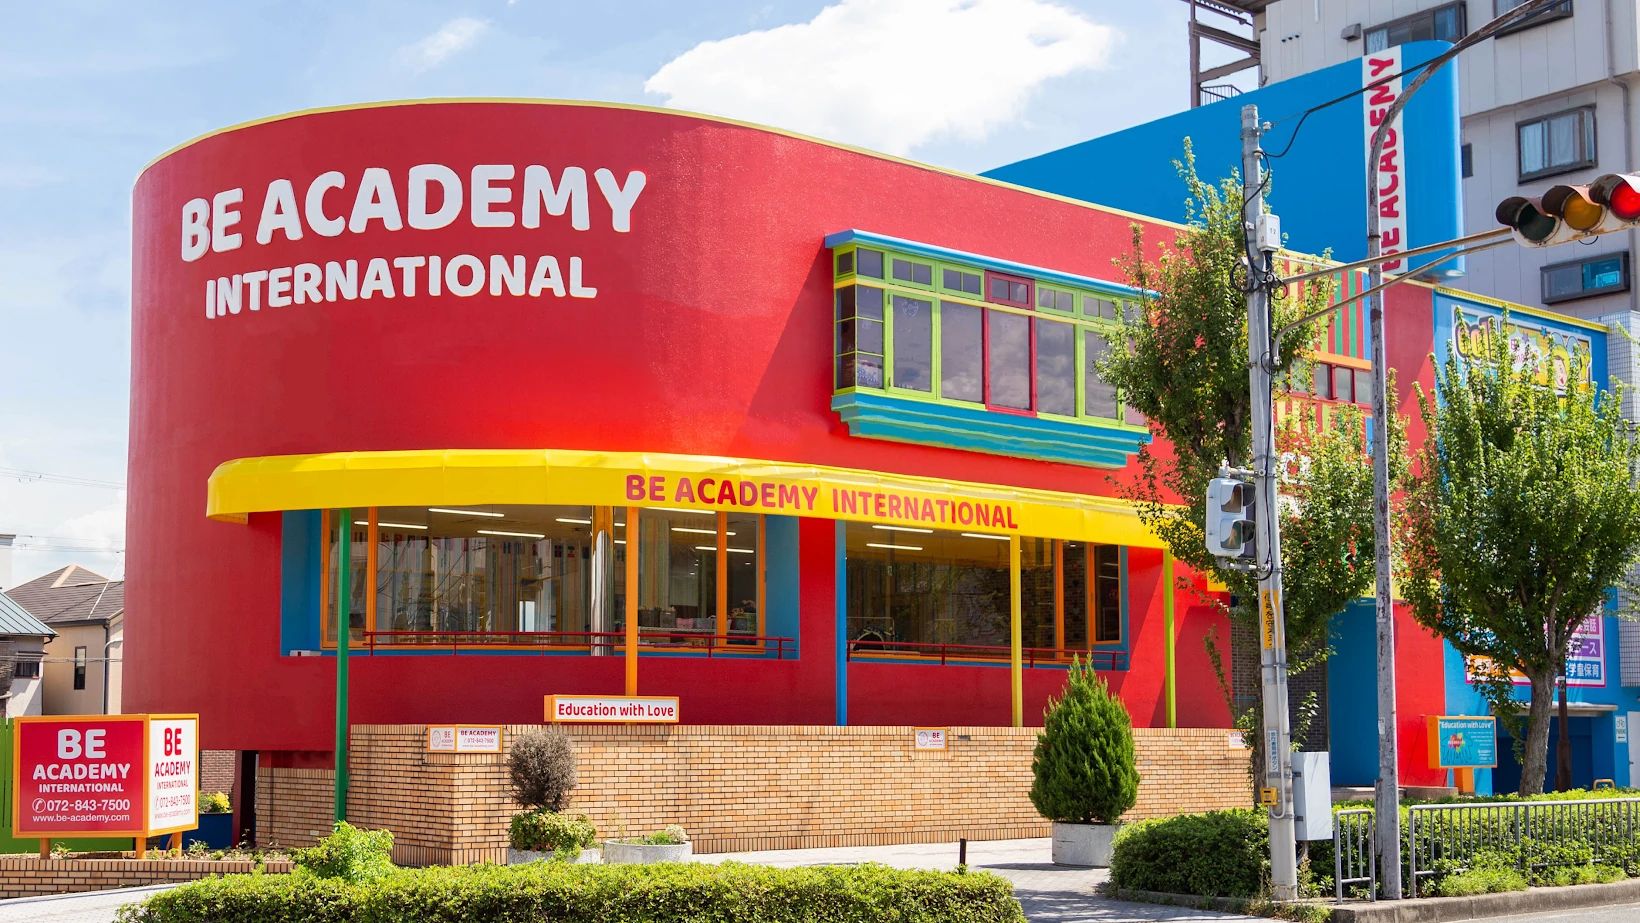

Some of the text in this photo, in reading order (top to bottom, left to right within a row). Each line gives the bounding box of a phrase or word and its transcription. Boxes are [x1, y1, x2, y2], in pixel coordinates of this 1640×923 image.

[181, 164, 647, 263] BE ACADEMY
[205, 254, 598, 319] INTERNATIONAL
[626, 474, 1019, 530] BE ACADEMY INTERNATIONAL
[1575, 617, 1597, 633] 会話
[1566, 662, 1600, 678] 学童保育
[558, 702, 674, 717] Education with Love
[57, 728, 107, 760] BE
[164, 727, 182, 757] BE
[32, 763, 131, 780] ACADEMY
[154, 761, 191, 777] ACADEMY
[39, 783, 124, 793] INTERNATIONAL
[156, 779, 189, 790] INTERNATIONAL
[46, 798, 131, 812] 072-843-7500
[32, 813, 130, 823] www.be-academy.com
